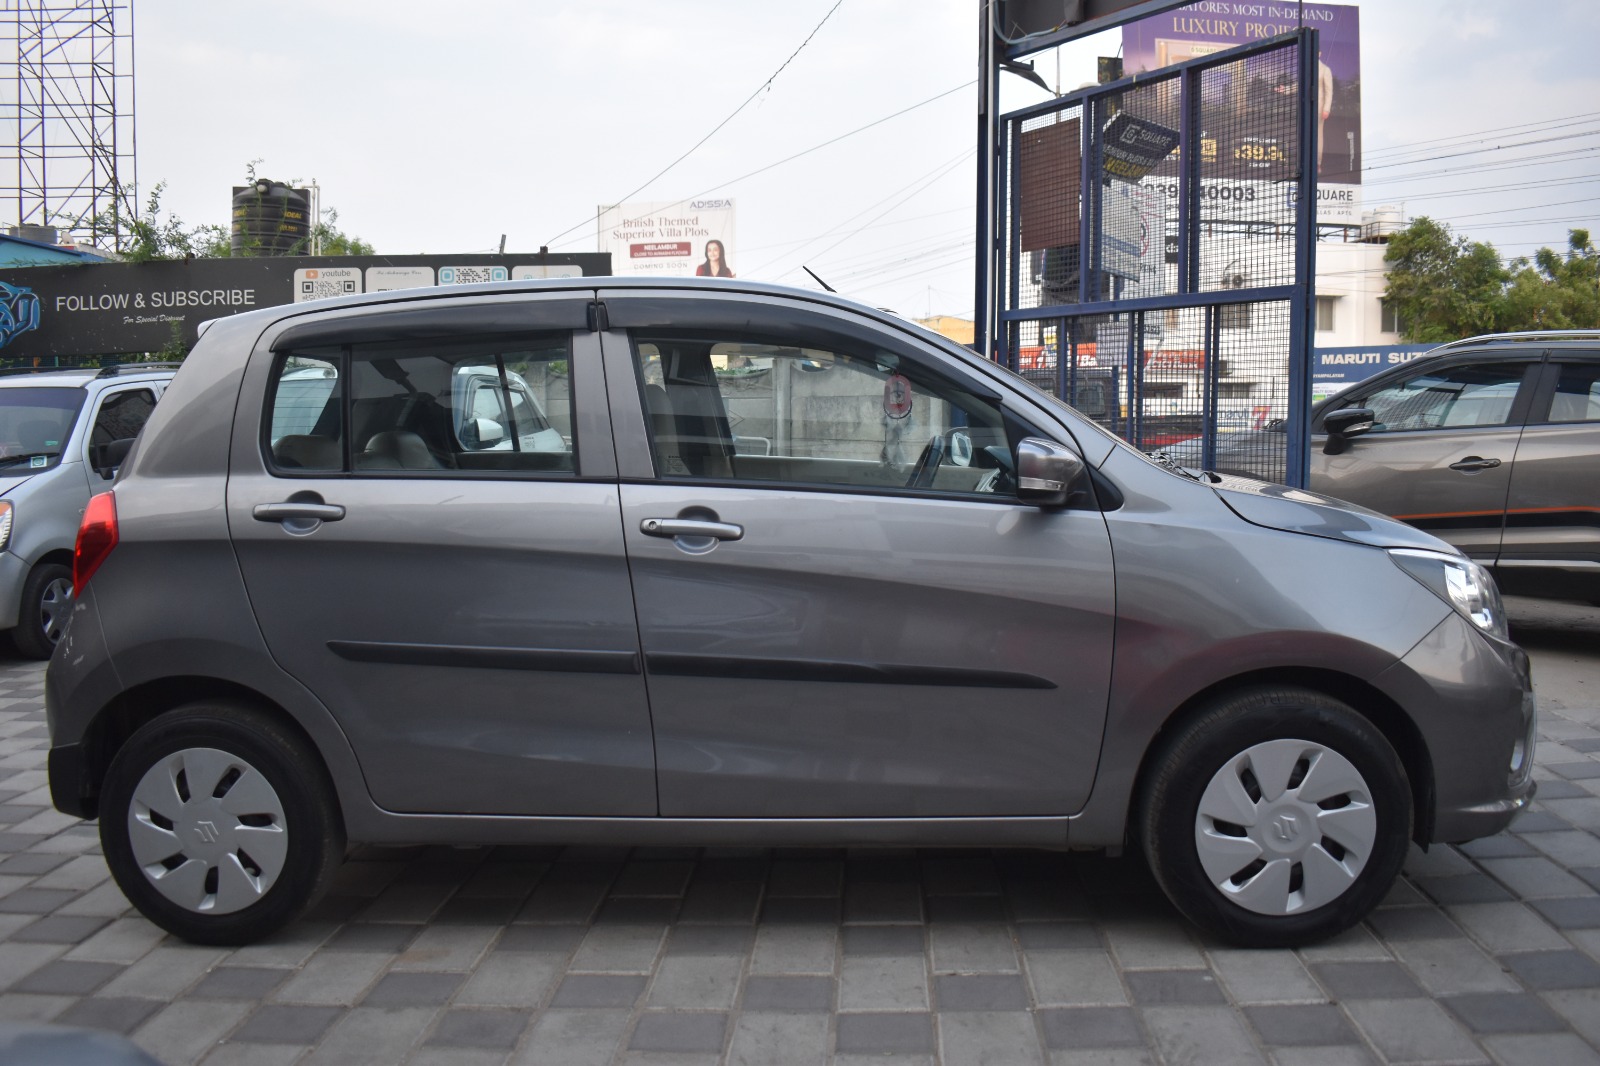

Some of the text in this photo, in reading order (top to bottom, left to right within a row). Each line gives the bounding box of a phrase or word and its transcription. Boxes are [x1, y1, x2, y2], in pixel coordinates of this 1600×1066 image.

[1178, 1, 1334, 22] ATORE'S MOST IN-DEMAND
[1173, 17, 1239, 37] LUXURY
[1316, 189, 1353, 202] QUARE
[623, 216, 699, 229] British Themed
[613, 227, 709, 242] Superior Villa Plots
[321, 269, 352, 279] youtube
[56, 289, 256, 312] FOLLOW & SUBSCRIBE
[123, 316, 135, 325] For
[135, 314, 159, 324] Special
[1321, 352, 1426, 365] MARUTI SUZ
